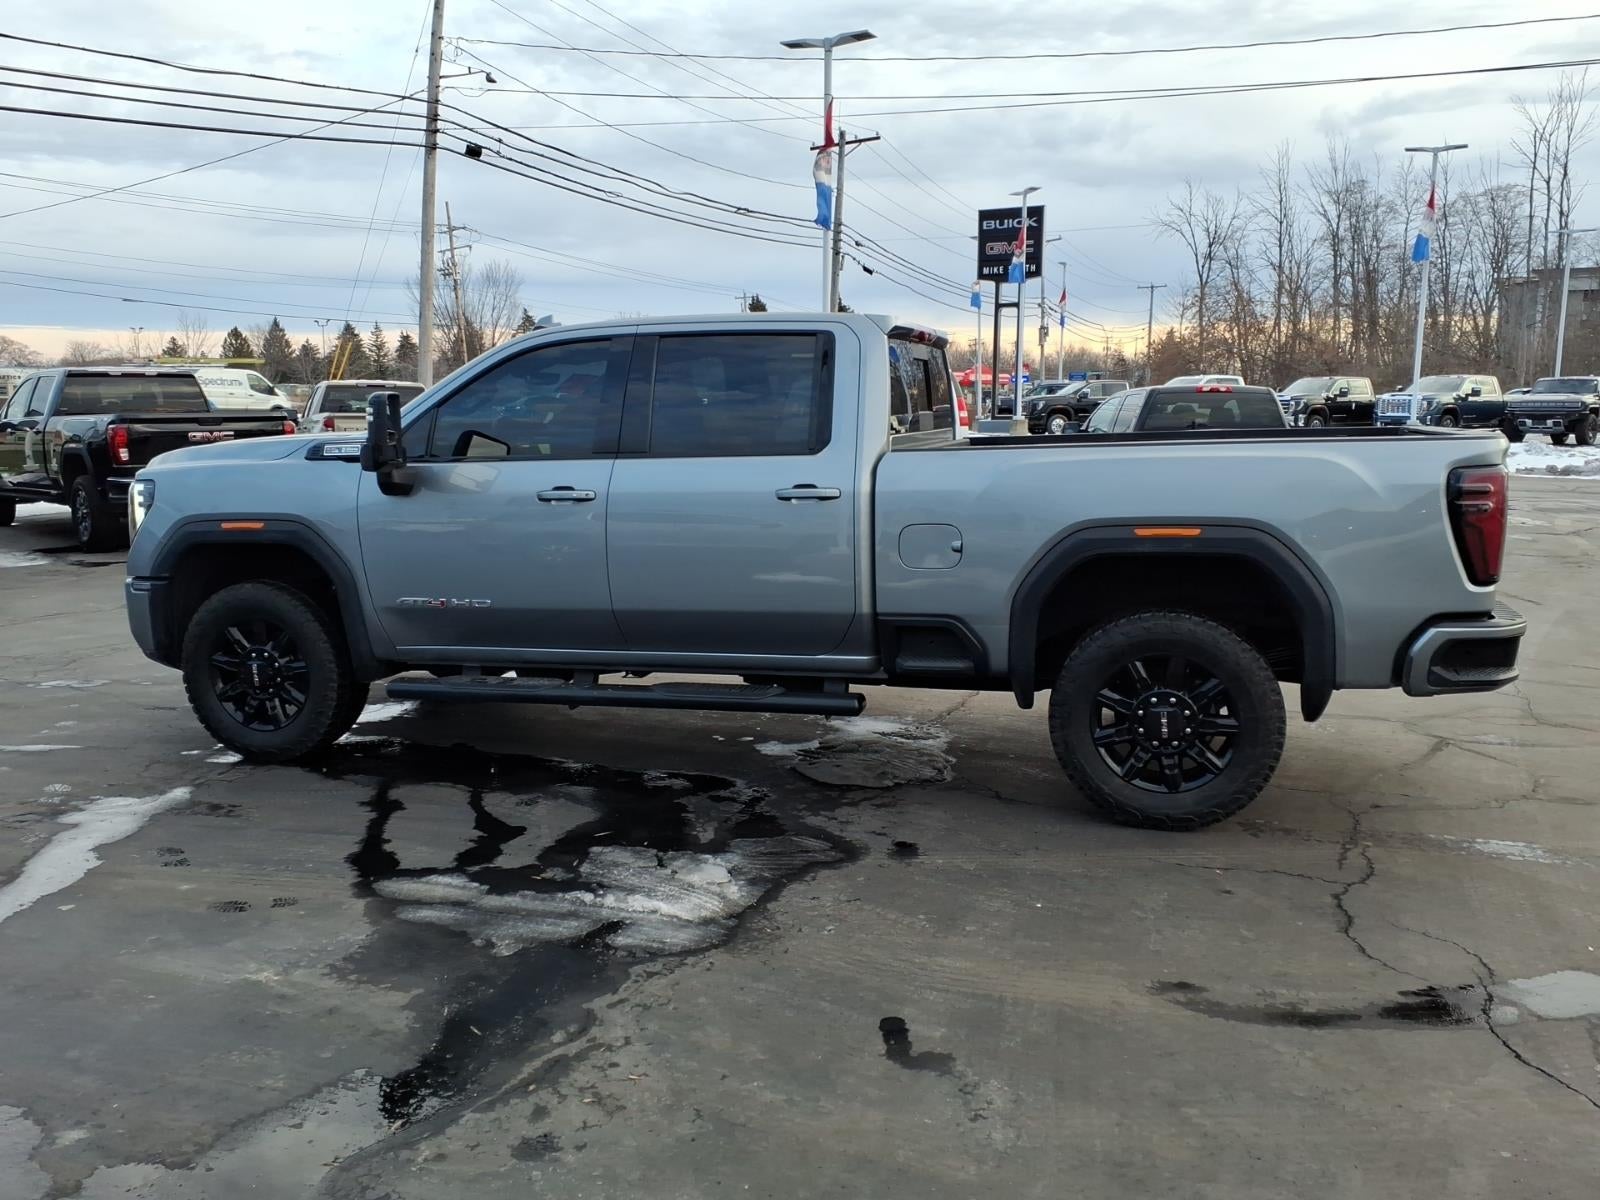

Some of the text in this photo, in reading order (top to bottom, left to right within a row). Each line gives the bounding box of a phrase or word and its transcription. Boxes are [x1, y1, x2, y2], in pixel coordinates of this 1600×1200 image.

[983, 217, 1038, 230] BUICK
[982, 265, 1005, 275] MIKE
[197, 376, 241, 388] Spectrum
[188, 431, 235, 442] GMC
[451, 598, 492, 608] HD
